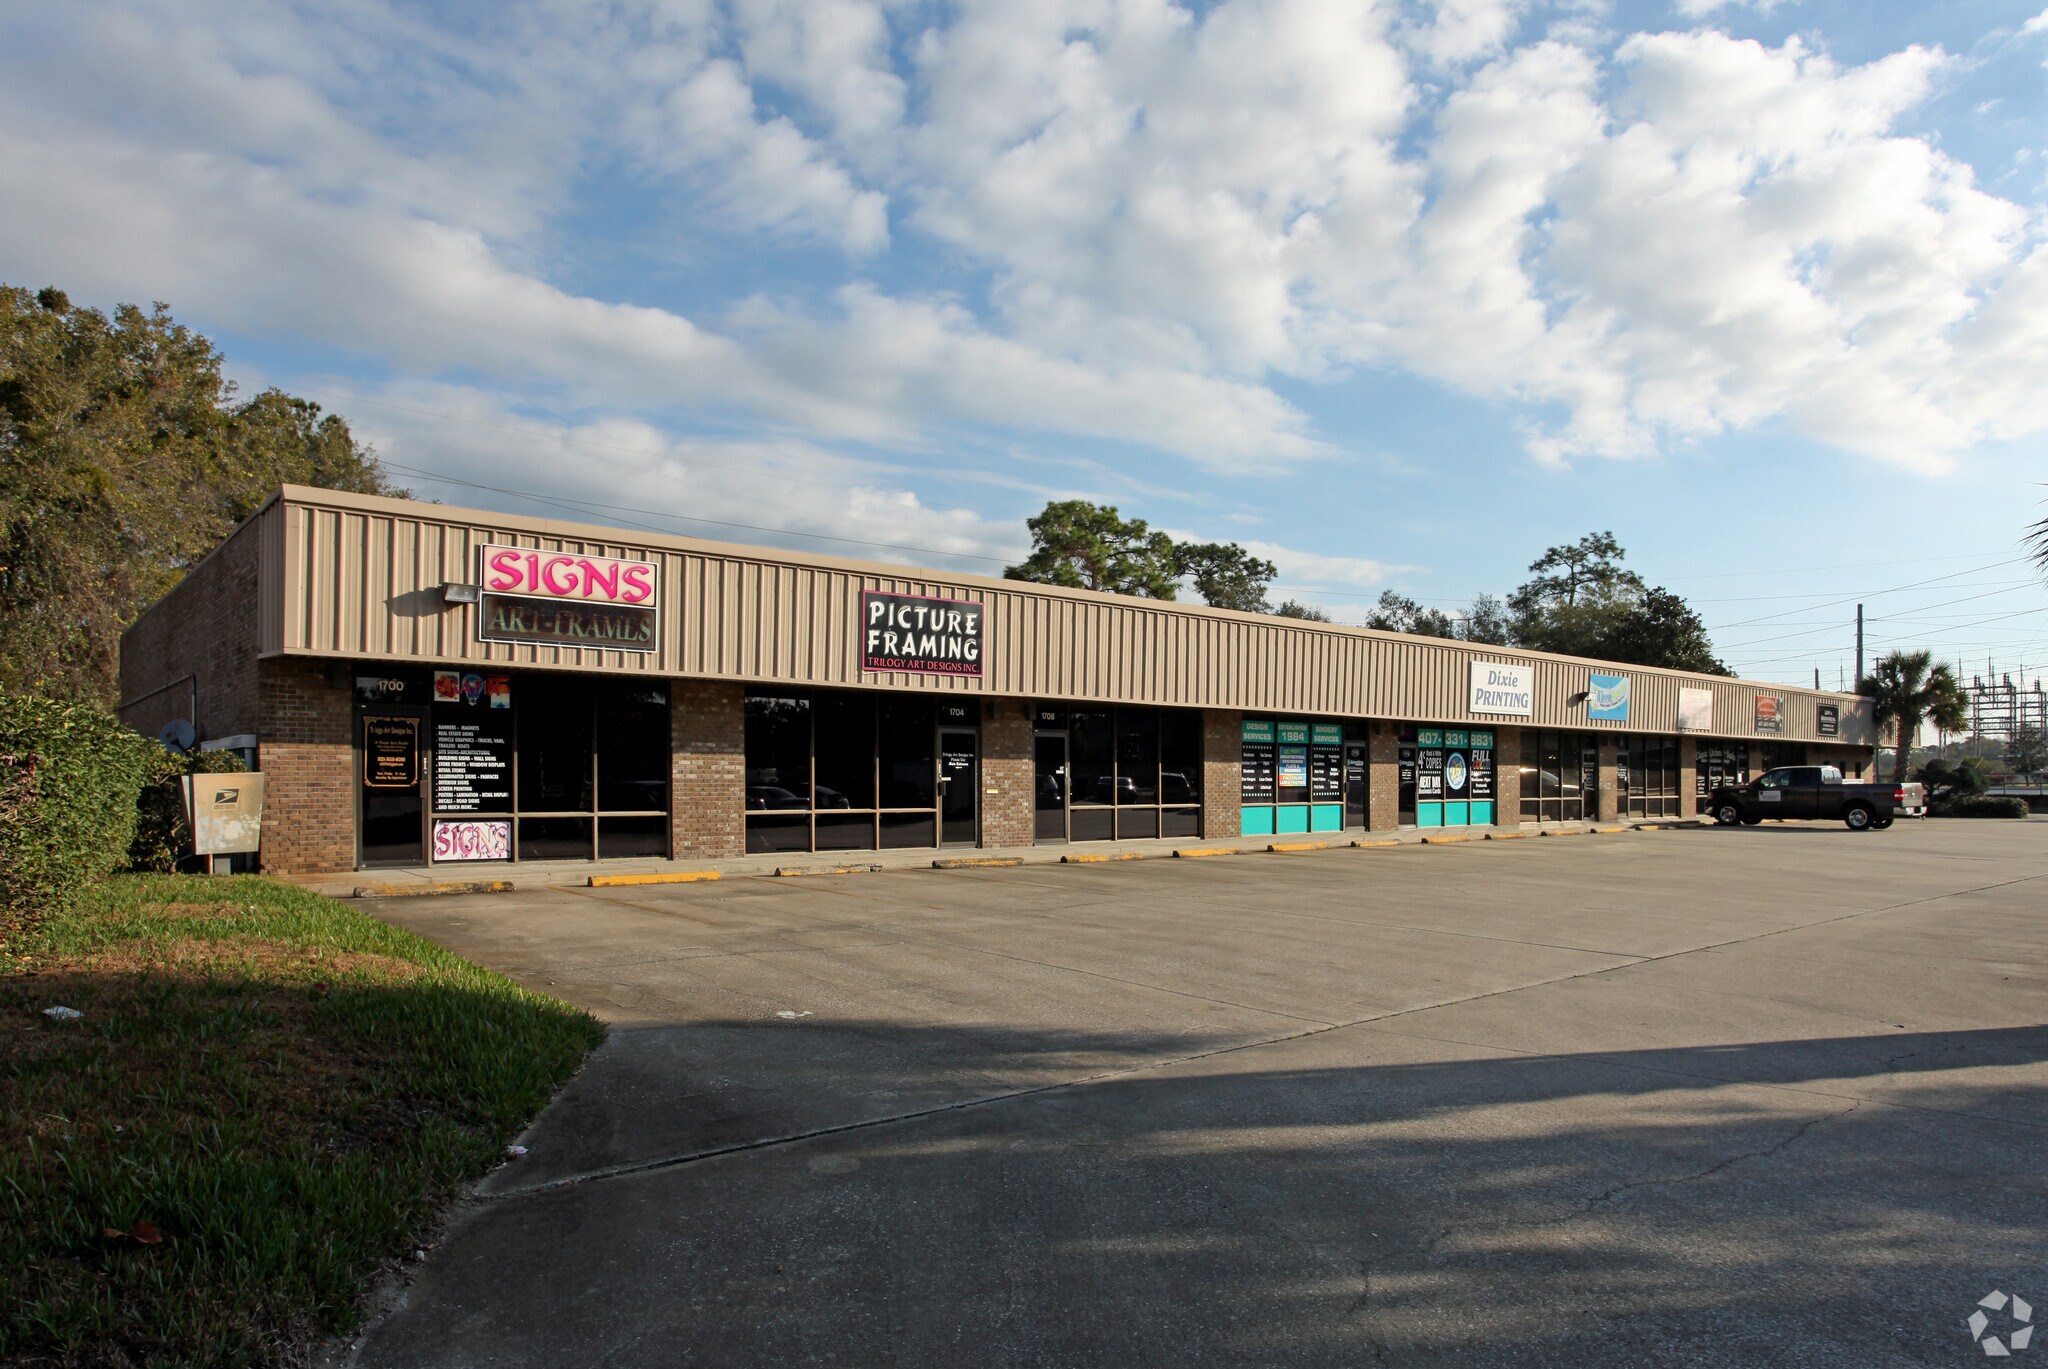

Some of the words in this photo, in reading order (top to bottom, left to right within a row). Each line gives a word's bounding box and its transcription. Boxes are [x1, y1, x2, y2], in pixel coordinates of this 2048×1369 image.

[490, 552, 651, 603] SIGNS
[869, 601, 979, 635] PICTURE
[868, 629, 978, 661] FRAMING
[868, 657, 906, 668] TRILOGY
[907, 660, 925, 669] ART
[927, 661, 962, 671] DESIGNS
[963, 663, 980, 672] INC.
[1488, 670, 1518, 687] Dixie
[379, 681, 404, 691] 1700
[1475, 688, 1529, 708] PRINTING
[950, 708, 964, 716] 1704
[1243, 732, 1272, 740] SERVICES
[1282, 732, 1304, 741] 1984
[1472, 750, 1490, 761] FULL
[1425, 757, 1442, 769] COPIES
[1420, 776, 1431, 788] NEXT
[1432, 776, 1441, 788] DAY
[436, 826, 508, 856] SIGNS
